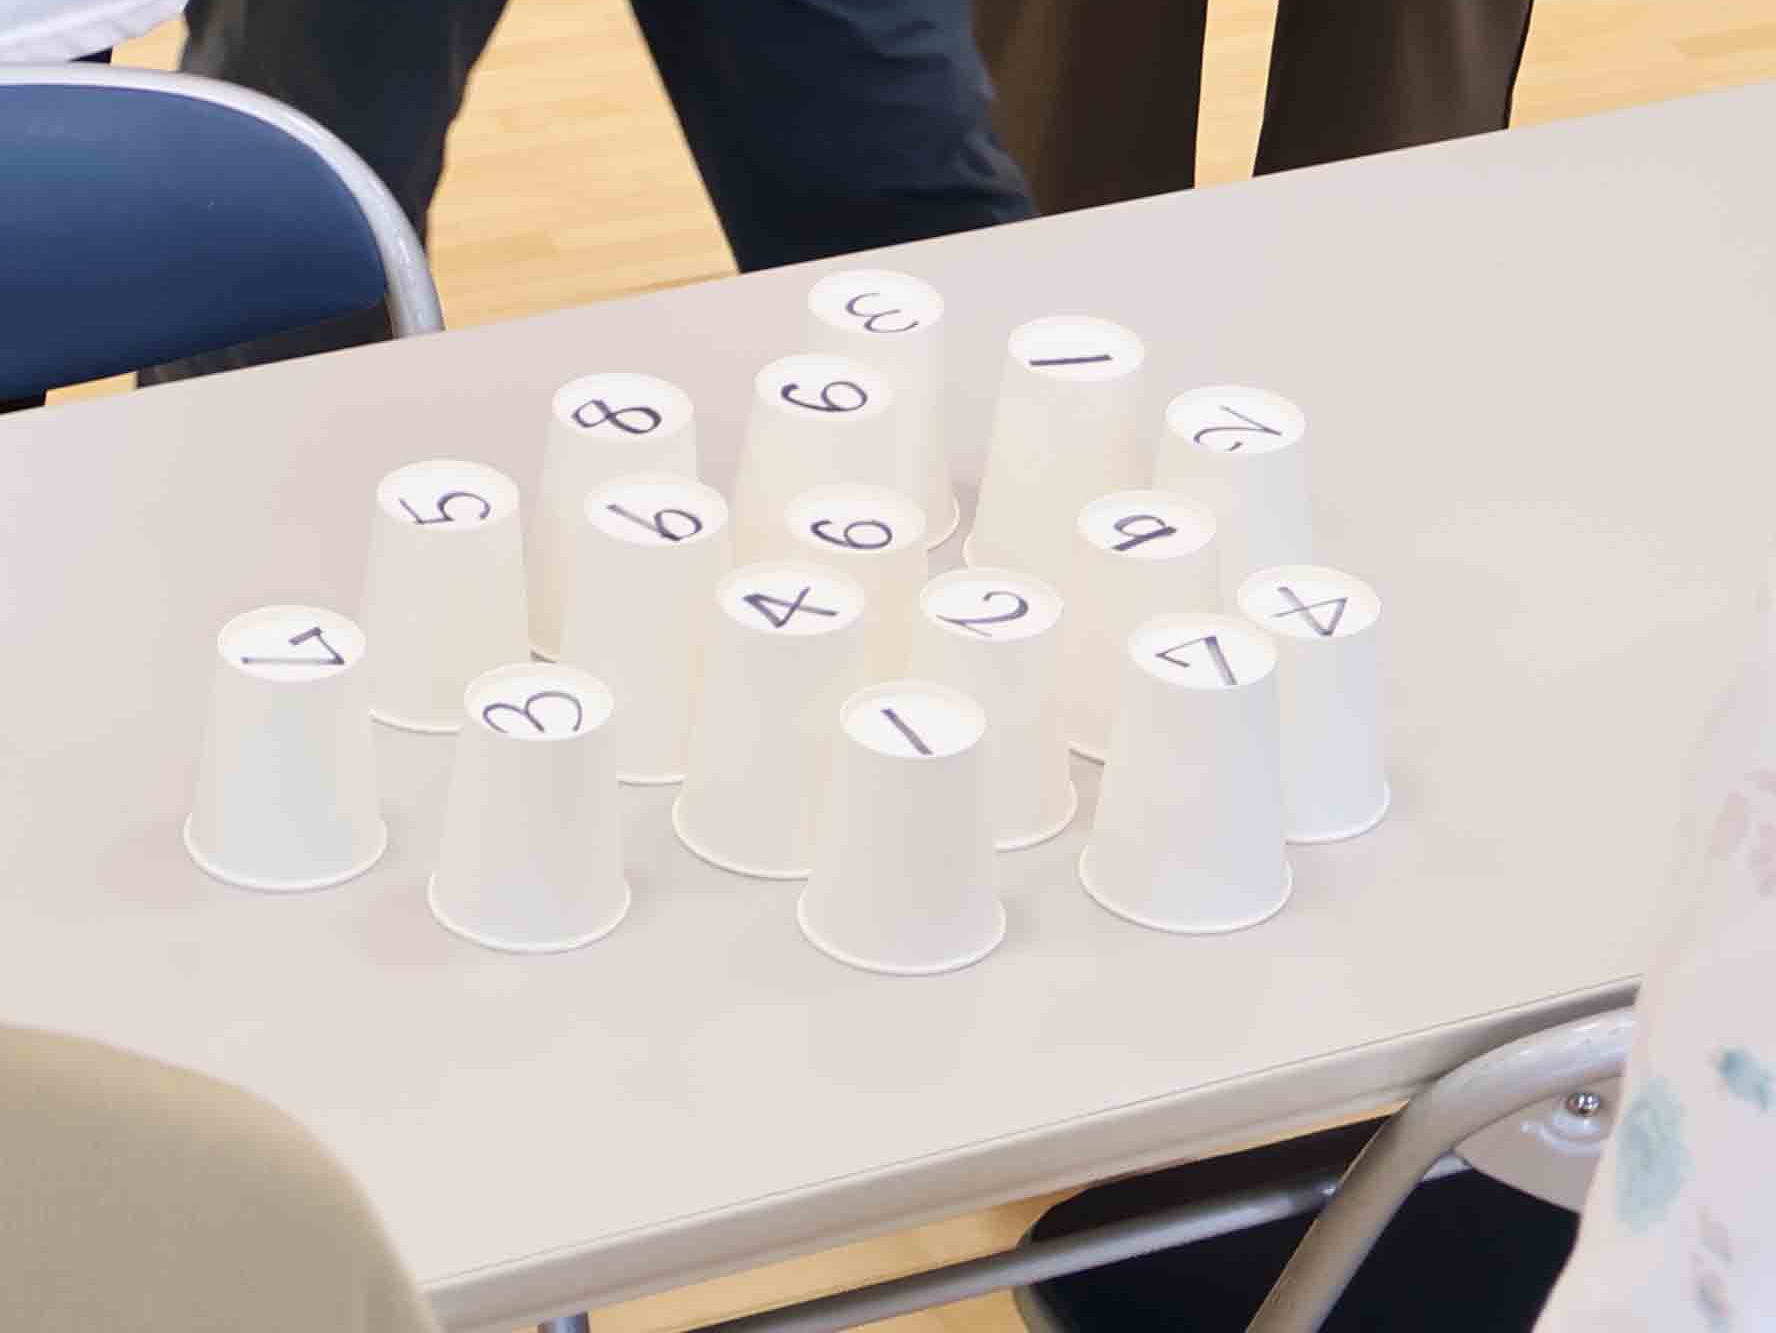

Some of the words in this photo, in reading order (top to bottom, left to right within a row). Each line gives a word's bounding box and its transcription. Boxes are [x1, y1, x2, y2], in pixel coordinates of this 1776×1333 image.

[844, 292, 920, 334] 3
[1028, 353, 1113, 367] 1
[570, 399, 663, 435] 8
[1192, 406, 1283, 452] 2
[399, 491, 492, 526] 5
[741, 586, 839, 629] 4
[935, 590, 1030, 637] 2
[1271, 586, 1350, 638] 4
[1154, 635, 1238, 686] 7
[482, 690, 583, 734] 3
[880, 708, 933, 756] 1
